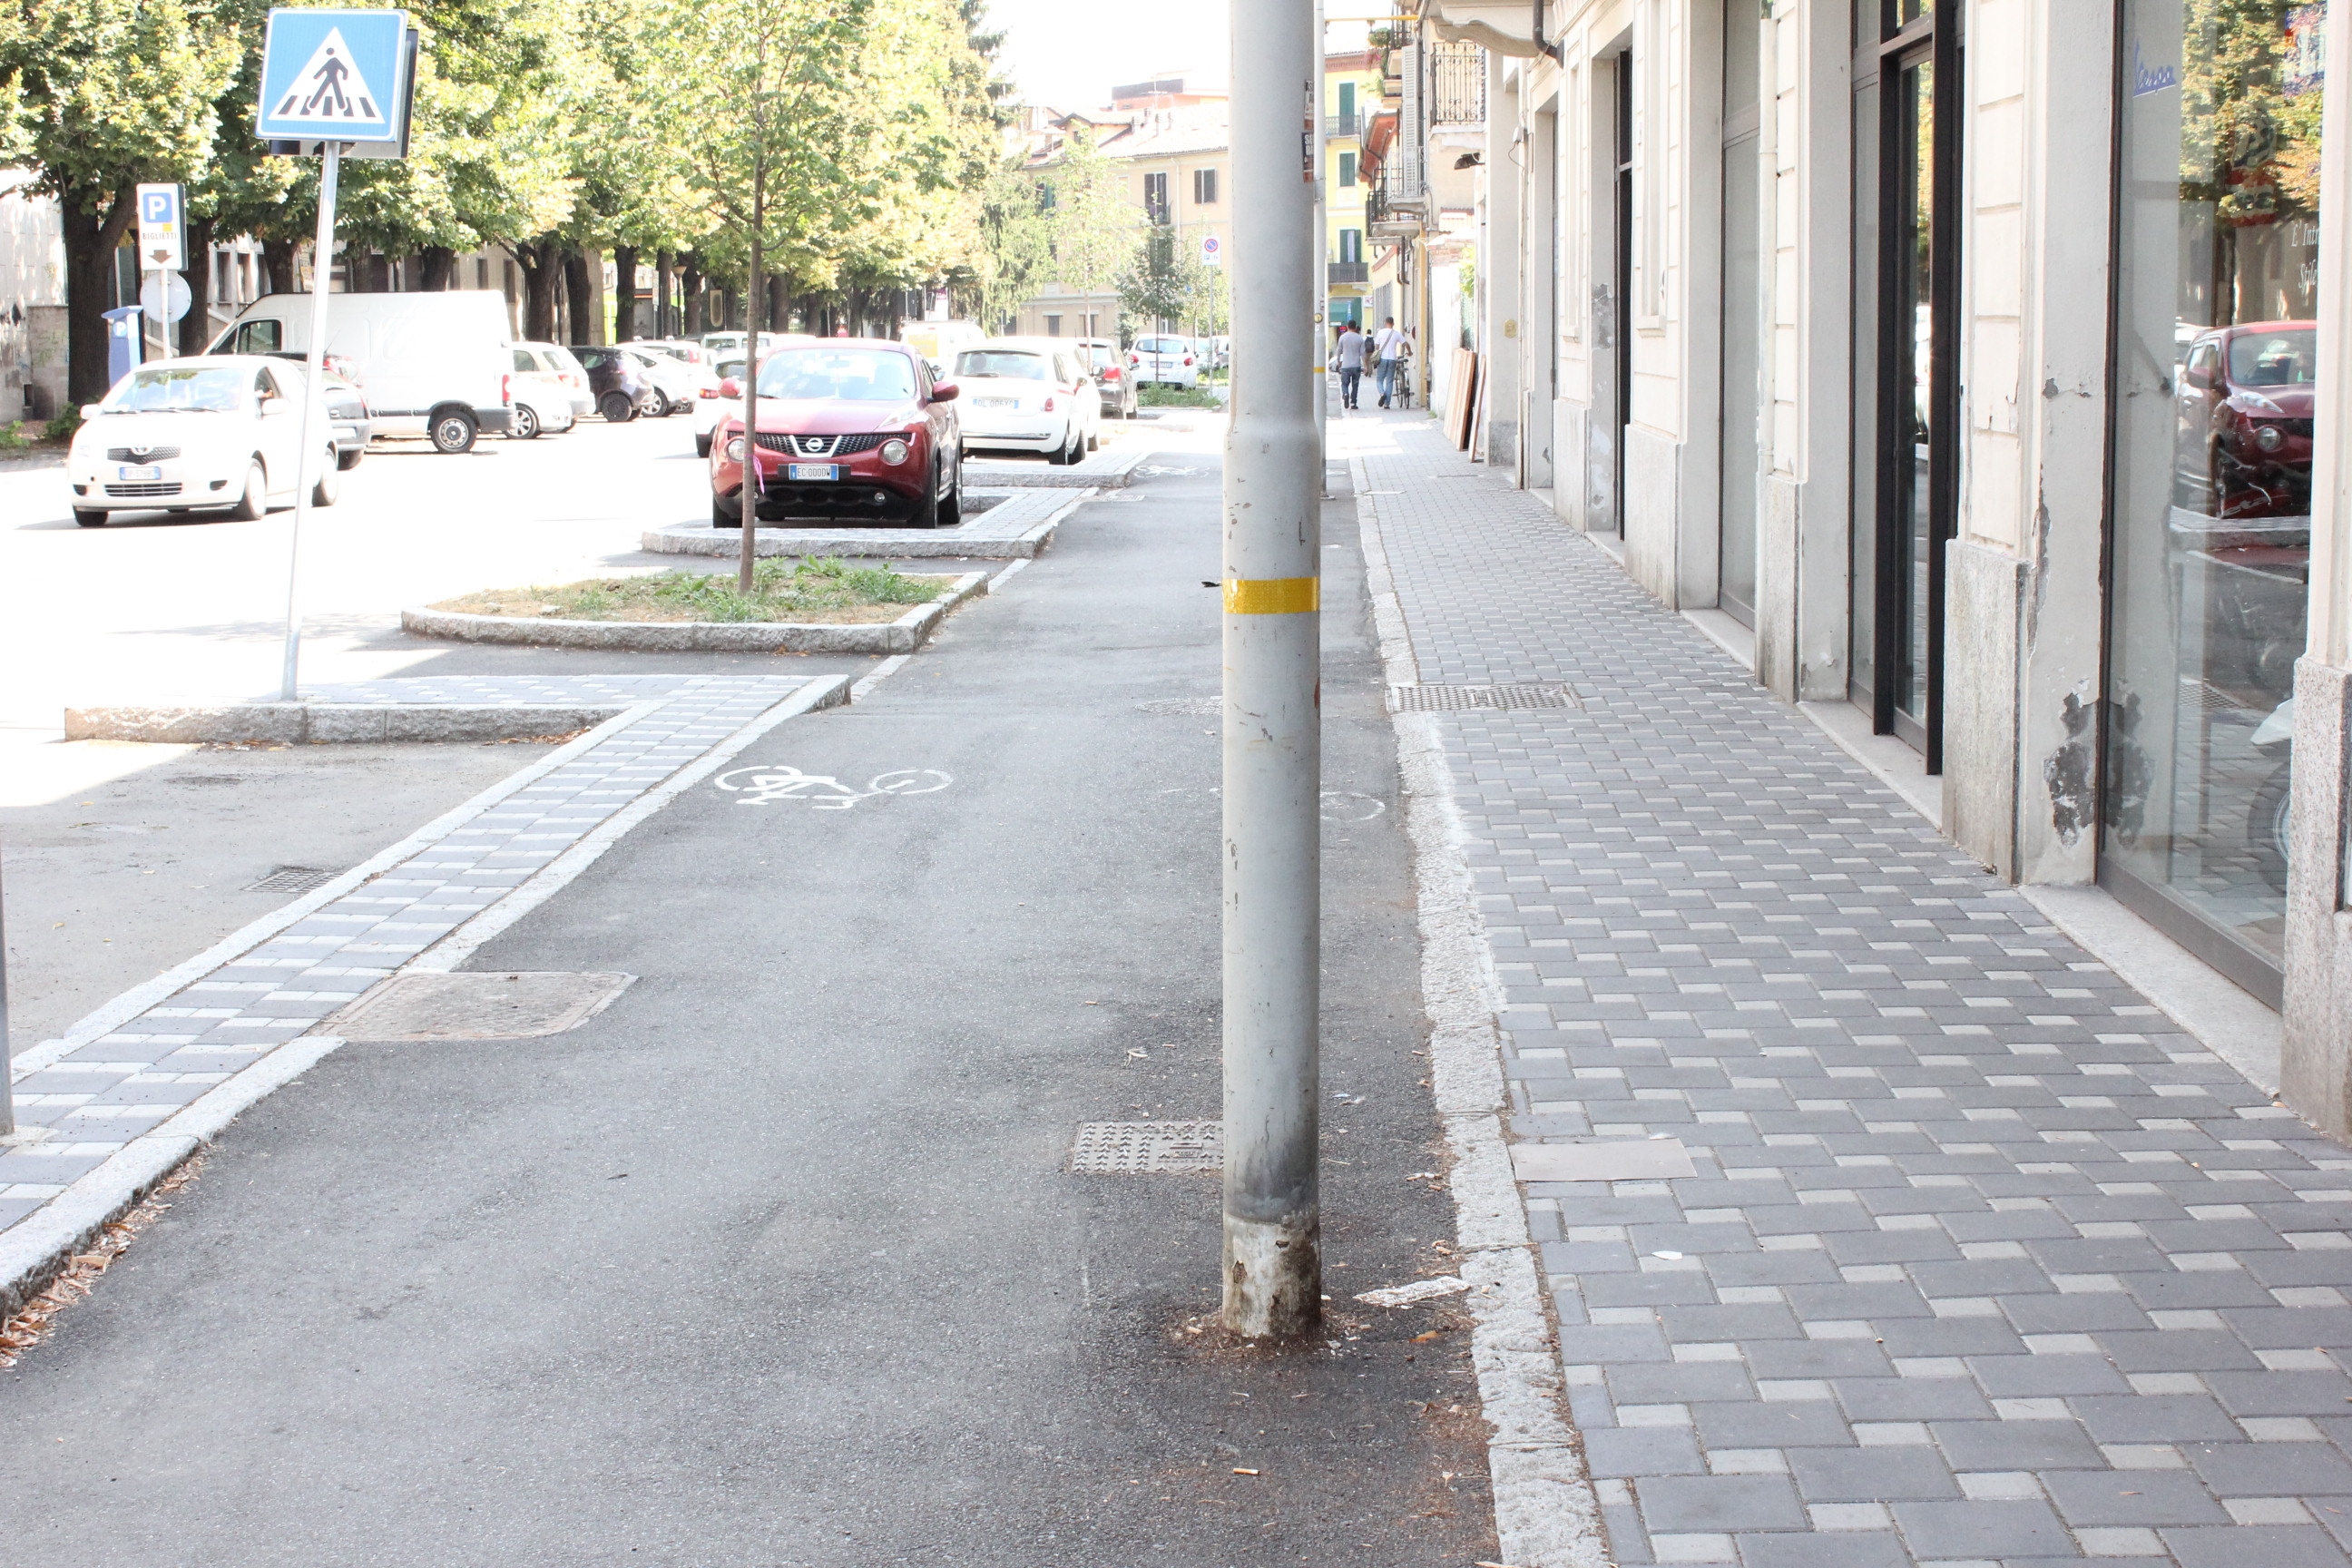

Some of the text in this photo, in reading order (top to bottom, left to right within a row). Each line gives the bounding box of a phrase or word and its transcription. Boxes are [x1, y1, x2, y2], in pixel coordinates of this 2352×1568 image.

[2132, 39, 2177, 97] Vespa
[148, 196, 167, 220] P
[142, 232, 178, 240] BIGLIETTI
[116, 322, 126, 337] P
